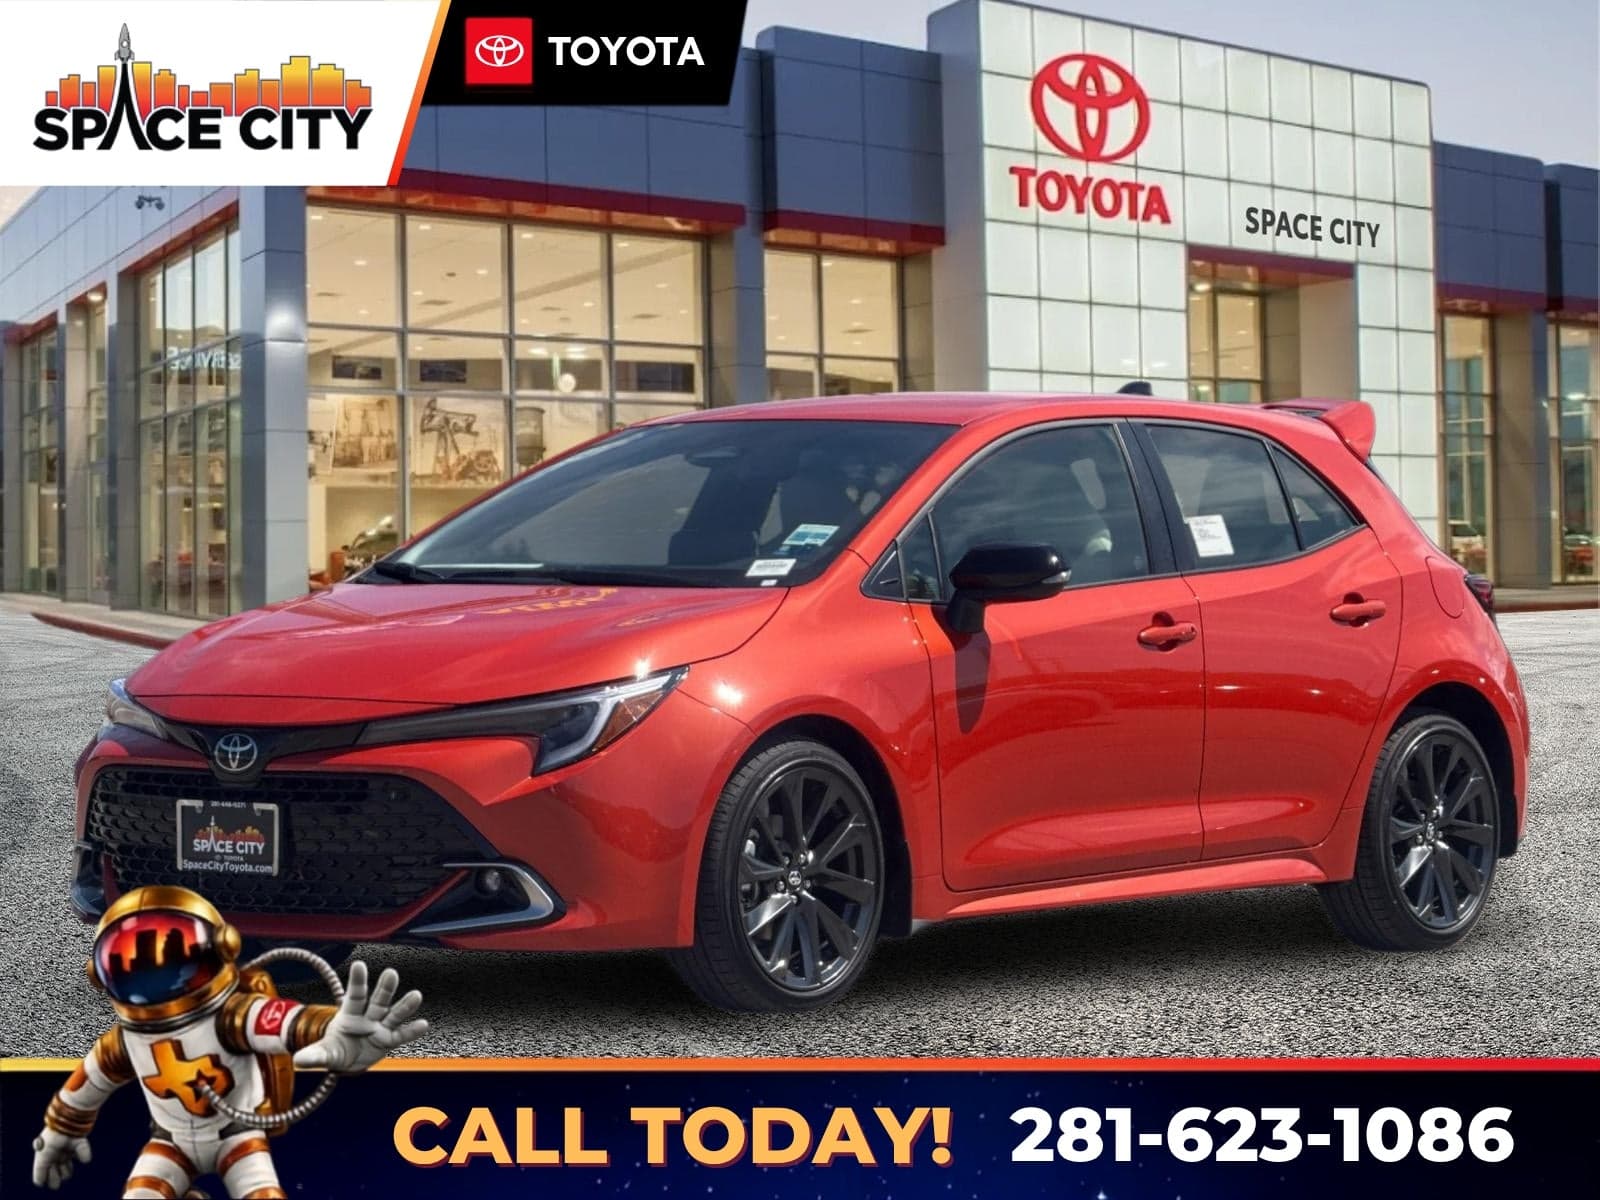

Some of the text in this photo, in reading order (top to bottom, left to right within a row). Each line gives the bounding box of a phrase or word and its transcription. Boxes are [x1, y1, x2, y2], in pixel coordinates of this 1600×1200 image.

[1009, 166, 1171, 224] TOYOTA
[1245, 206, 1380, 247] SPACE CITY
[193, 839, 265, 854] SPACE CITY
[183, 860, 273, 873] SpaceCityToyota.com
